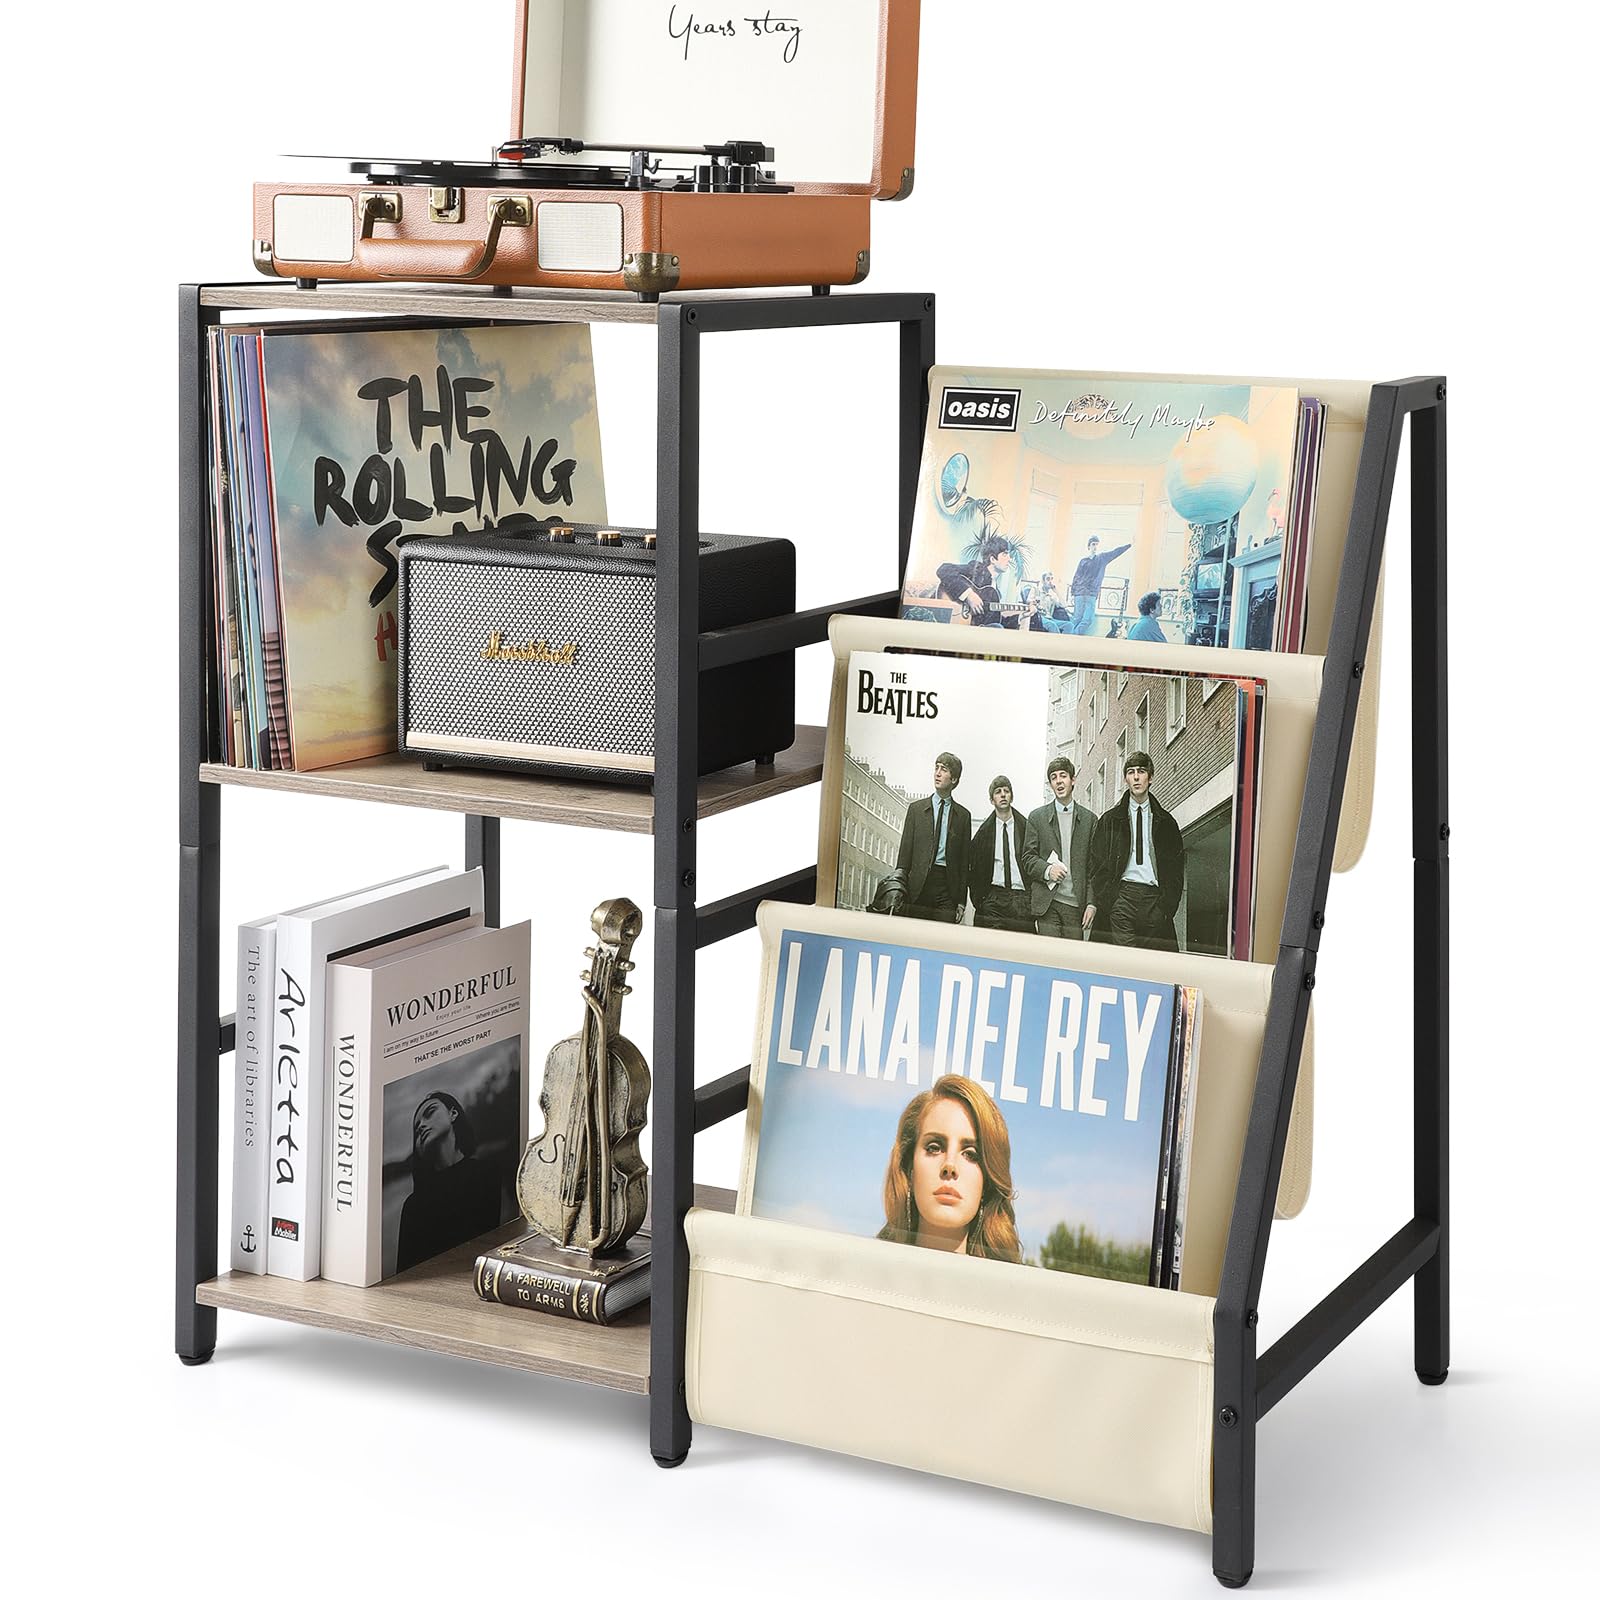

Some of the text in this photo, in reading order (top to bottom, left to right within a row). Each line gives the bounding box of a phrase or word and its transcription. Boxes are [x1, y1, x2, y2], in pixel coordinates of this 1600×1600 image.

[669, 4, 803, 63] Years stay
[357, 364, 495, 453] THE
[948, 398, 1011, 421] oasis
[1029, 399, 1217, 442] Definitely Maybe
[314, 435, 578, 528] ROLLING
[857, 669, 939, 724] BEATLES
[890, 671, 908, 684] THE
[386, 966, 518, 1028] WONDERFUL
[450, 1007, 462, 1018] your
[475, 1010, 491, 1020] Where
[490, 1007, 500, 1017] you
[508, 1001, 520, 1010] there
[244, 945, 260, 1147] The art of libraries
[386, 1044, 394, 1052] am
[395, 1042, 401, 1050] on
[401, 1039, 410, 1049] my
[410, 1035, 420, 1046] way
[425, 1029, 439, 1039] future
[413, 1029, 492, 1064] THAT'SE THE WORST PART
[777, 942, 922, 1086] LANA
[931, 963, 1028, 1104] DEL
[1040, 980, 1163, 1121] REY
[336, 1033, 356, 1213] WONDERFUL
[504, 1271, 571, 1296] A FAREWELL
[517, 1289, 566, 1309] TO ARMS
